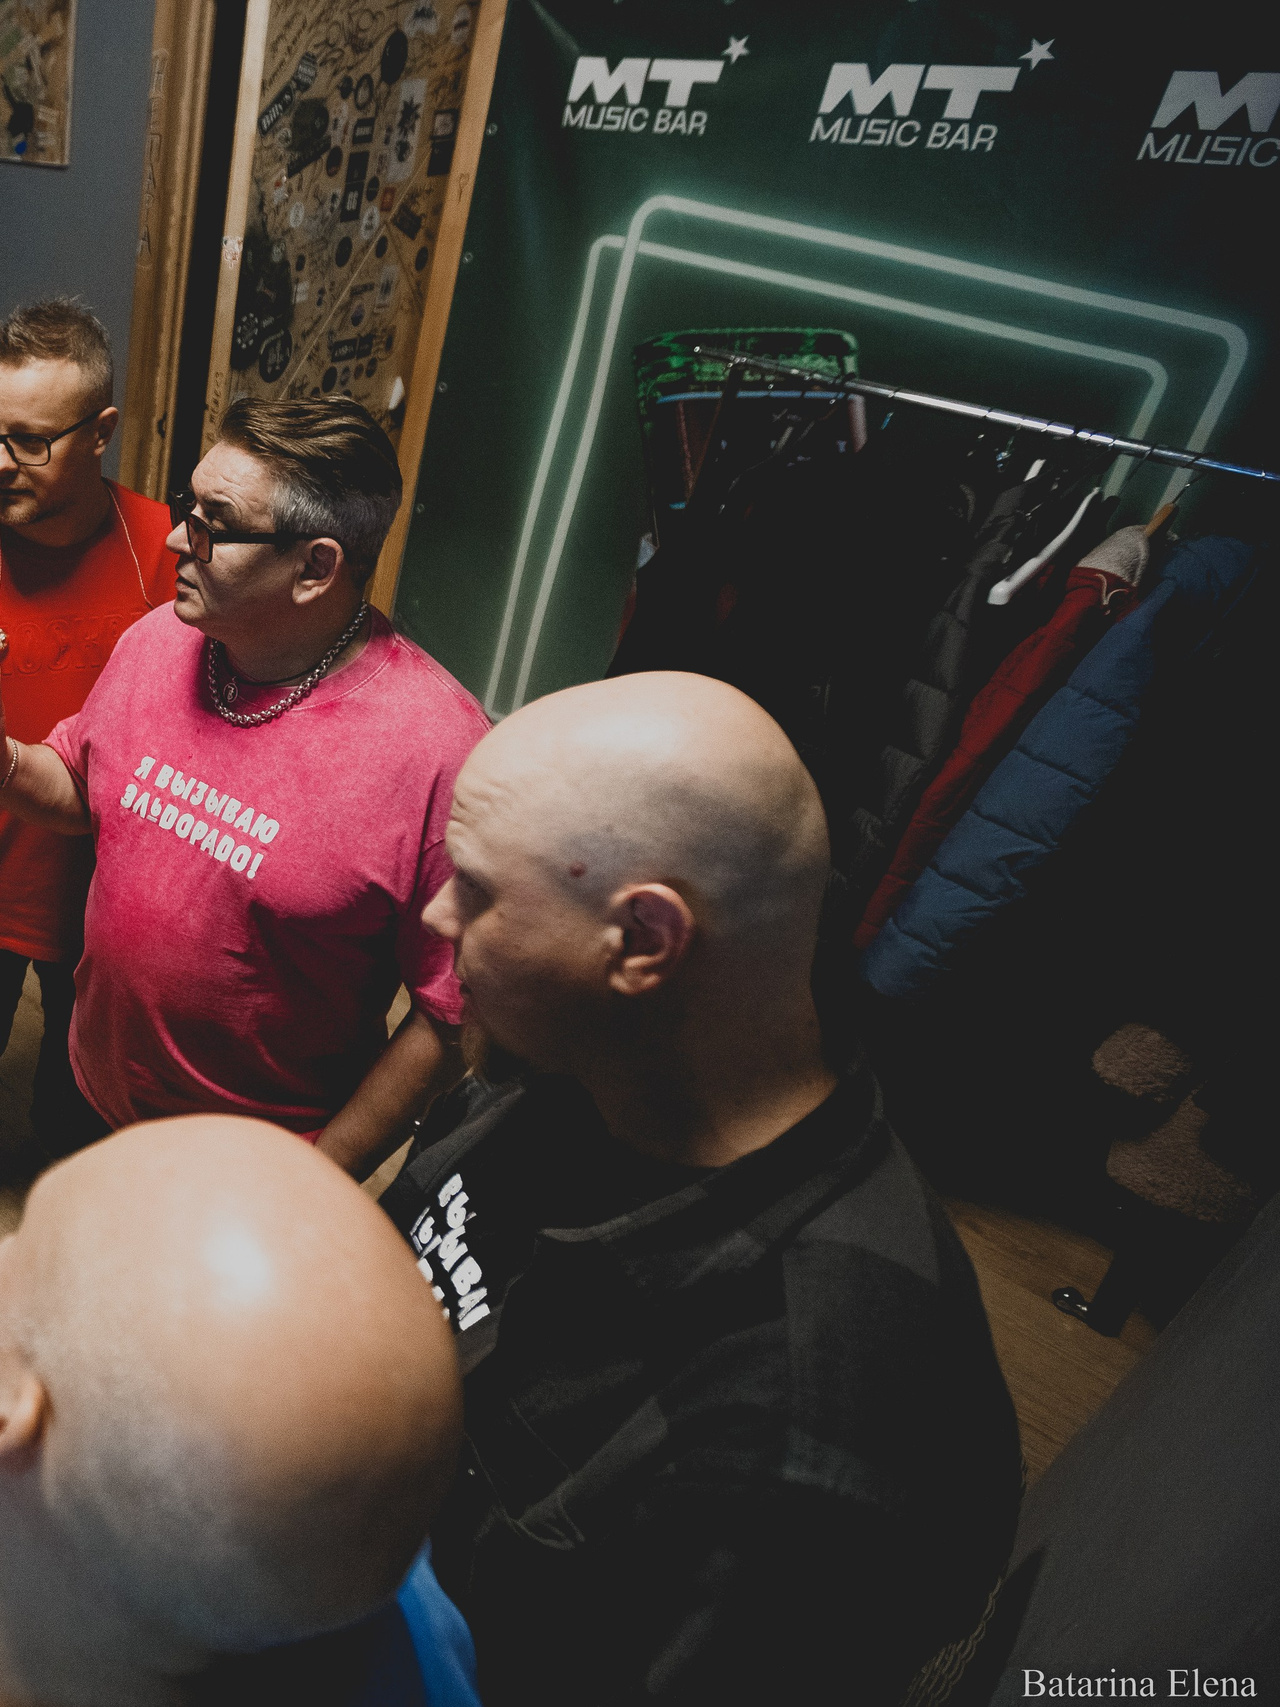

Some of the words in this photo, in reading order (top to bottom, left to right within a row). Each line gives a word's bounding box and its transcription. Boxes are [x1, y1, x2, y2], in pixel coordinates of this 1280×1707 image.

[567, 56, 725, 107] MT
[818, 62, 1021, 119] MT
[563, 104, 650, 132] MUSIC
[653, 108, 708, 136] BAR
[809, 116, 921, 147] MUSIC
[925, 121, 998, 151] BAR
[1136, 132, 1280, 167] MUSIC
[134, 755, 157, 780] Я
[154, 763, 280, 844] ВЫЗЫВАЮ
